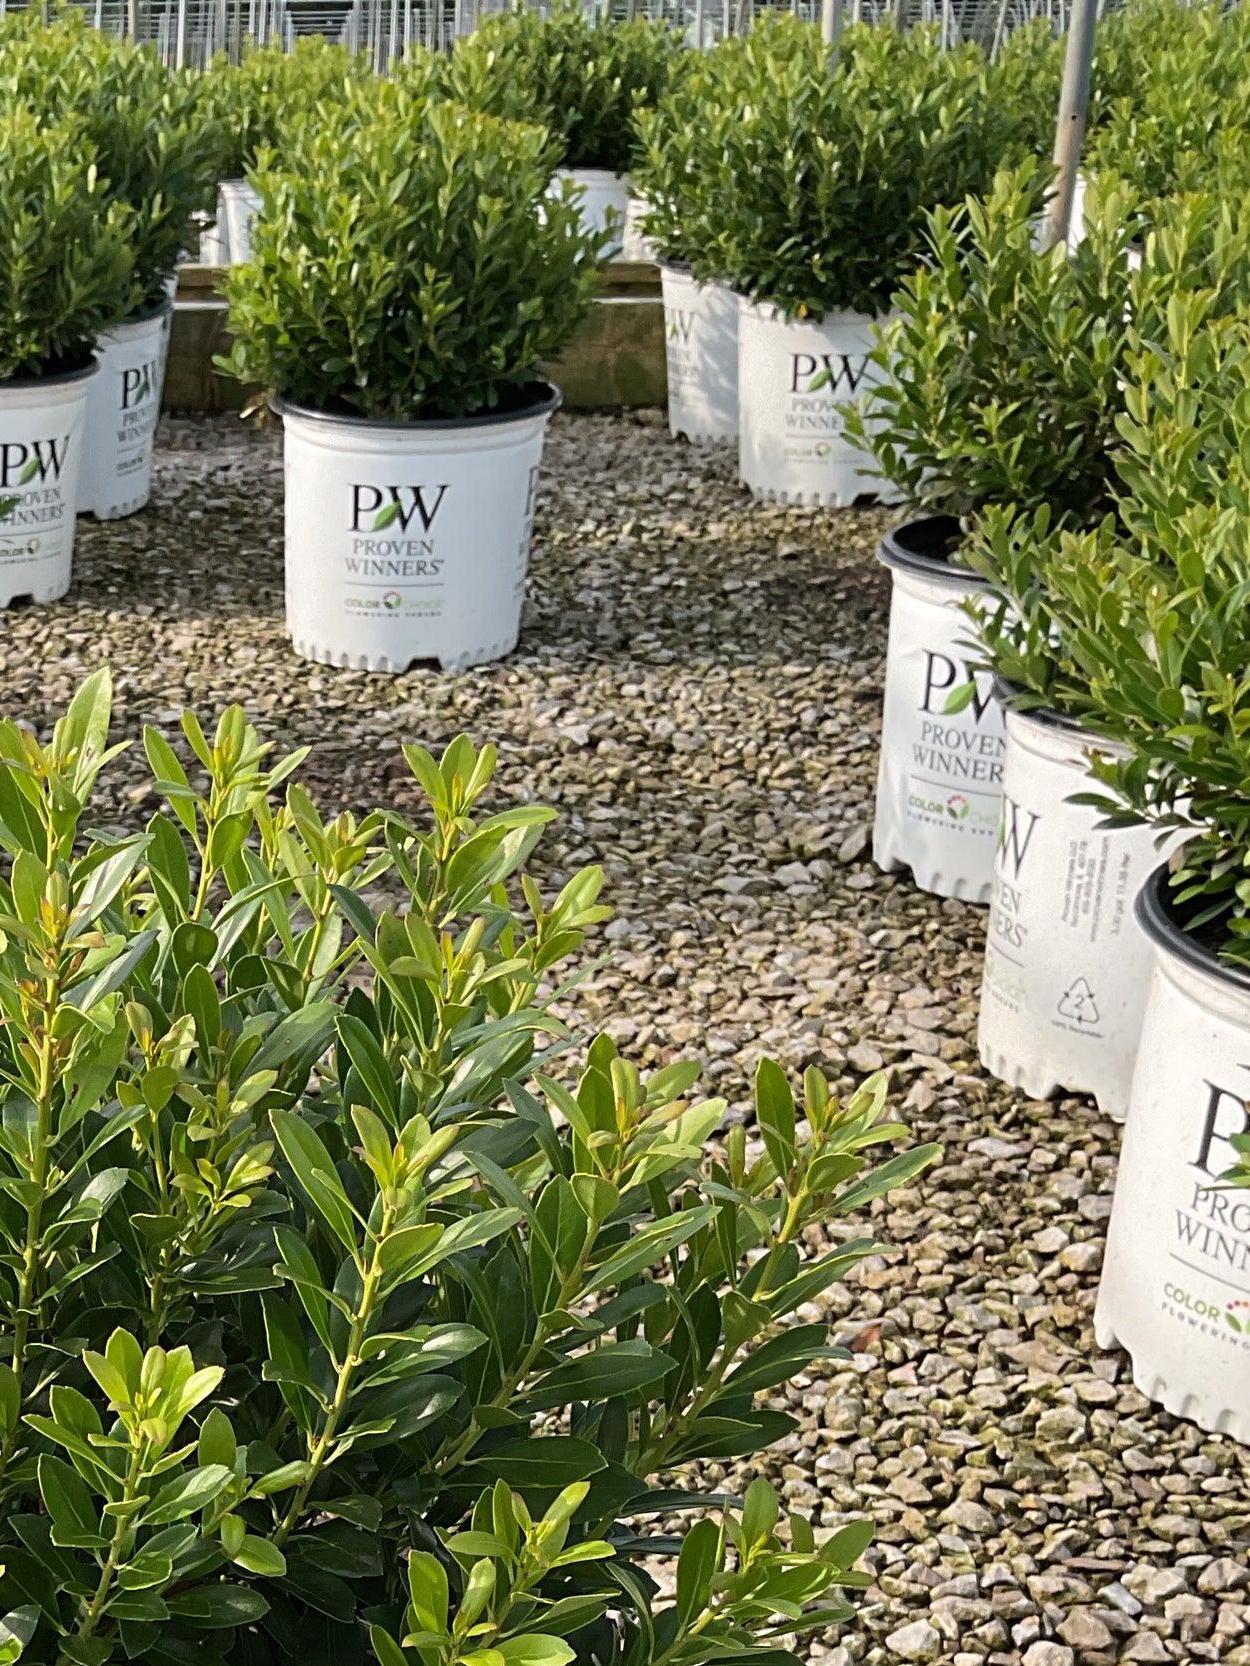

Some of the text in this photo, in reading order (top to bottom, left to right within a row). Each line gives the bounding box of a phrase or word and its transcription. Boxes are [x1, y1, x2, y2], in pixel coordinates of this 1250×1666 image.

[789, 352, 870, 394] PW
[346, 482, 452, 535] PW
[352, 537, 436, 556] PROVEN
[912, 743, 1005, 782] WINNER
[1164, 1282, 1220, 1323] COLOR
